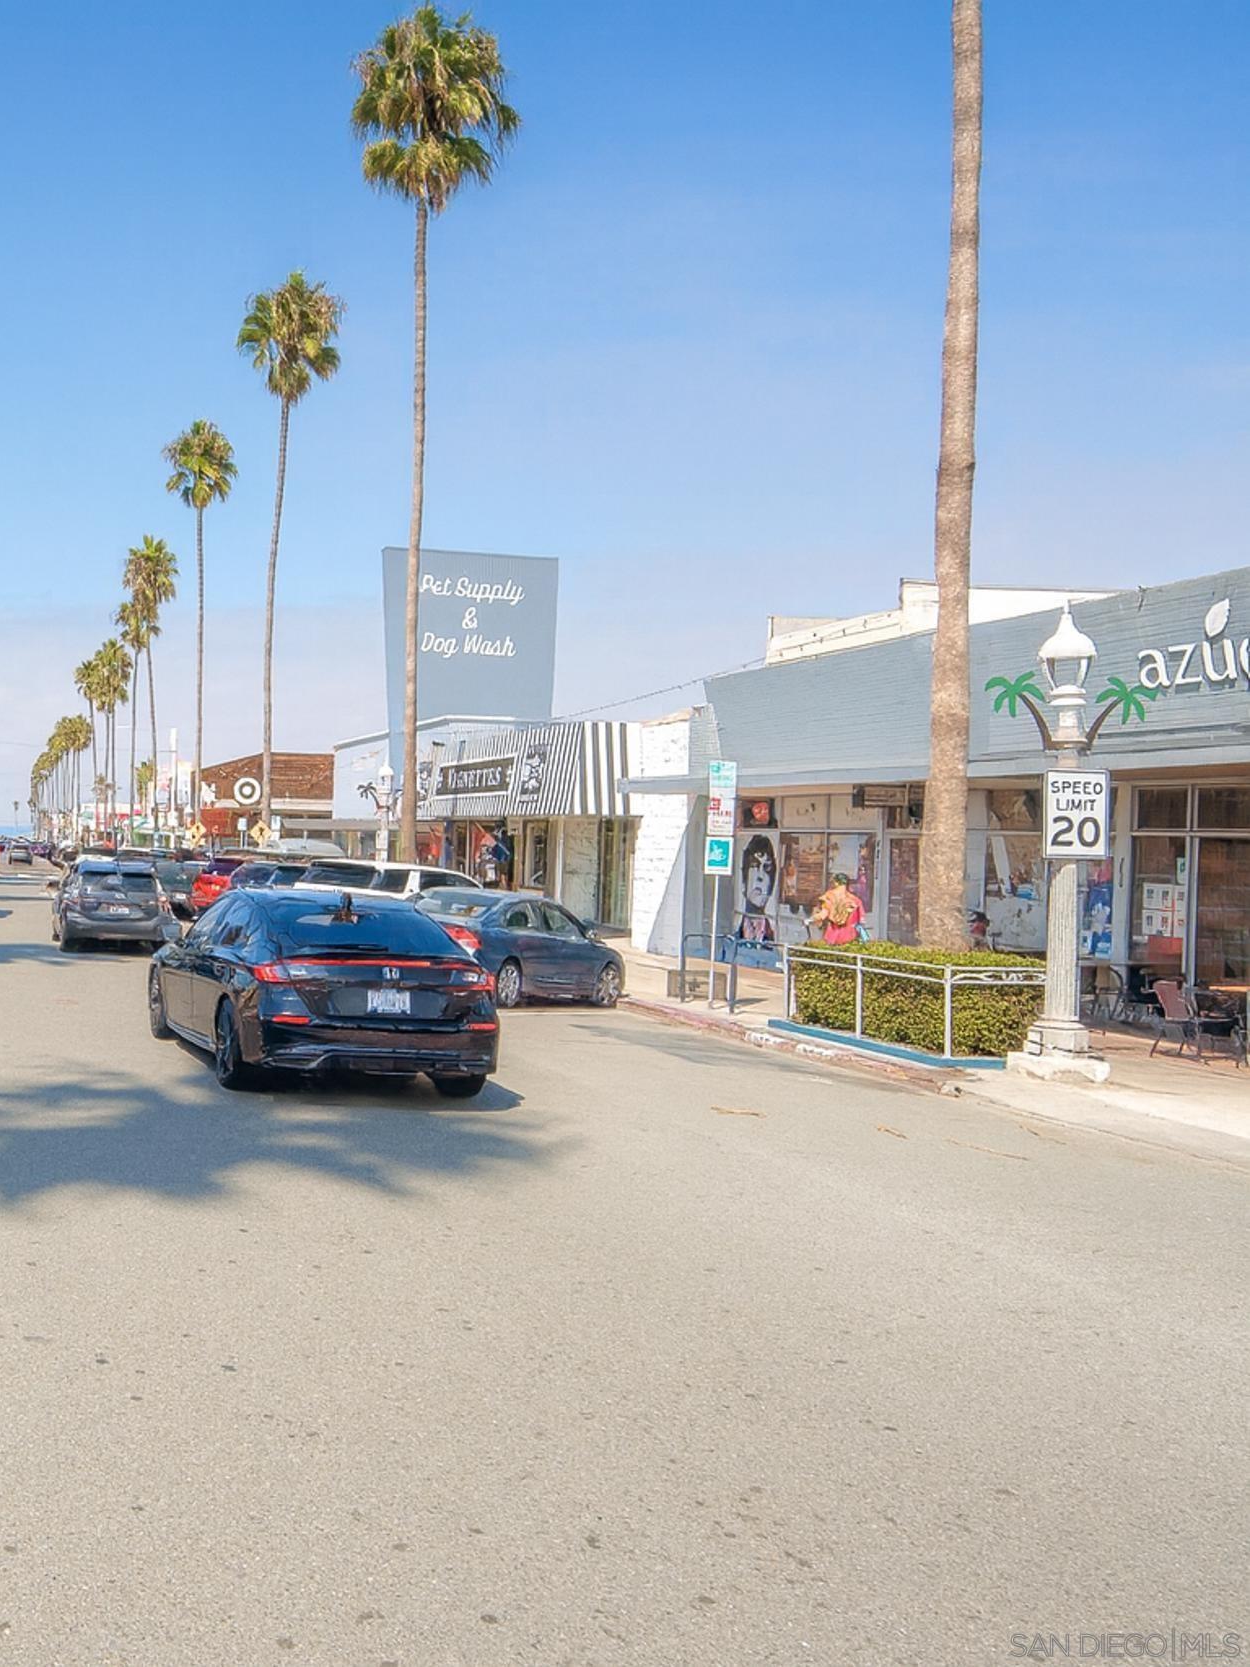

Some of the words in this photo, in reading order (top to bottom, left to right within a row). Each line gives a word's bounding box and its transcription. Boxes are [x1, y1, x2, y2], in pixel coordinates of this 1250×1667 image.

[419, 573, 453, 596] Pet
[454, 576, 526, 606] Supply
[461, 606, 479, 630] &
[421, 631, 460, 659] Dog
[463, 633, 517, 657] Wash
[1050, 780, 1104, 796] SPEED
[1055, 798, 1097, 812] LIMIT
[1050, 815, 1102, 848] 20
